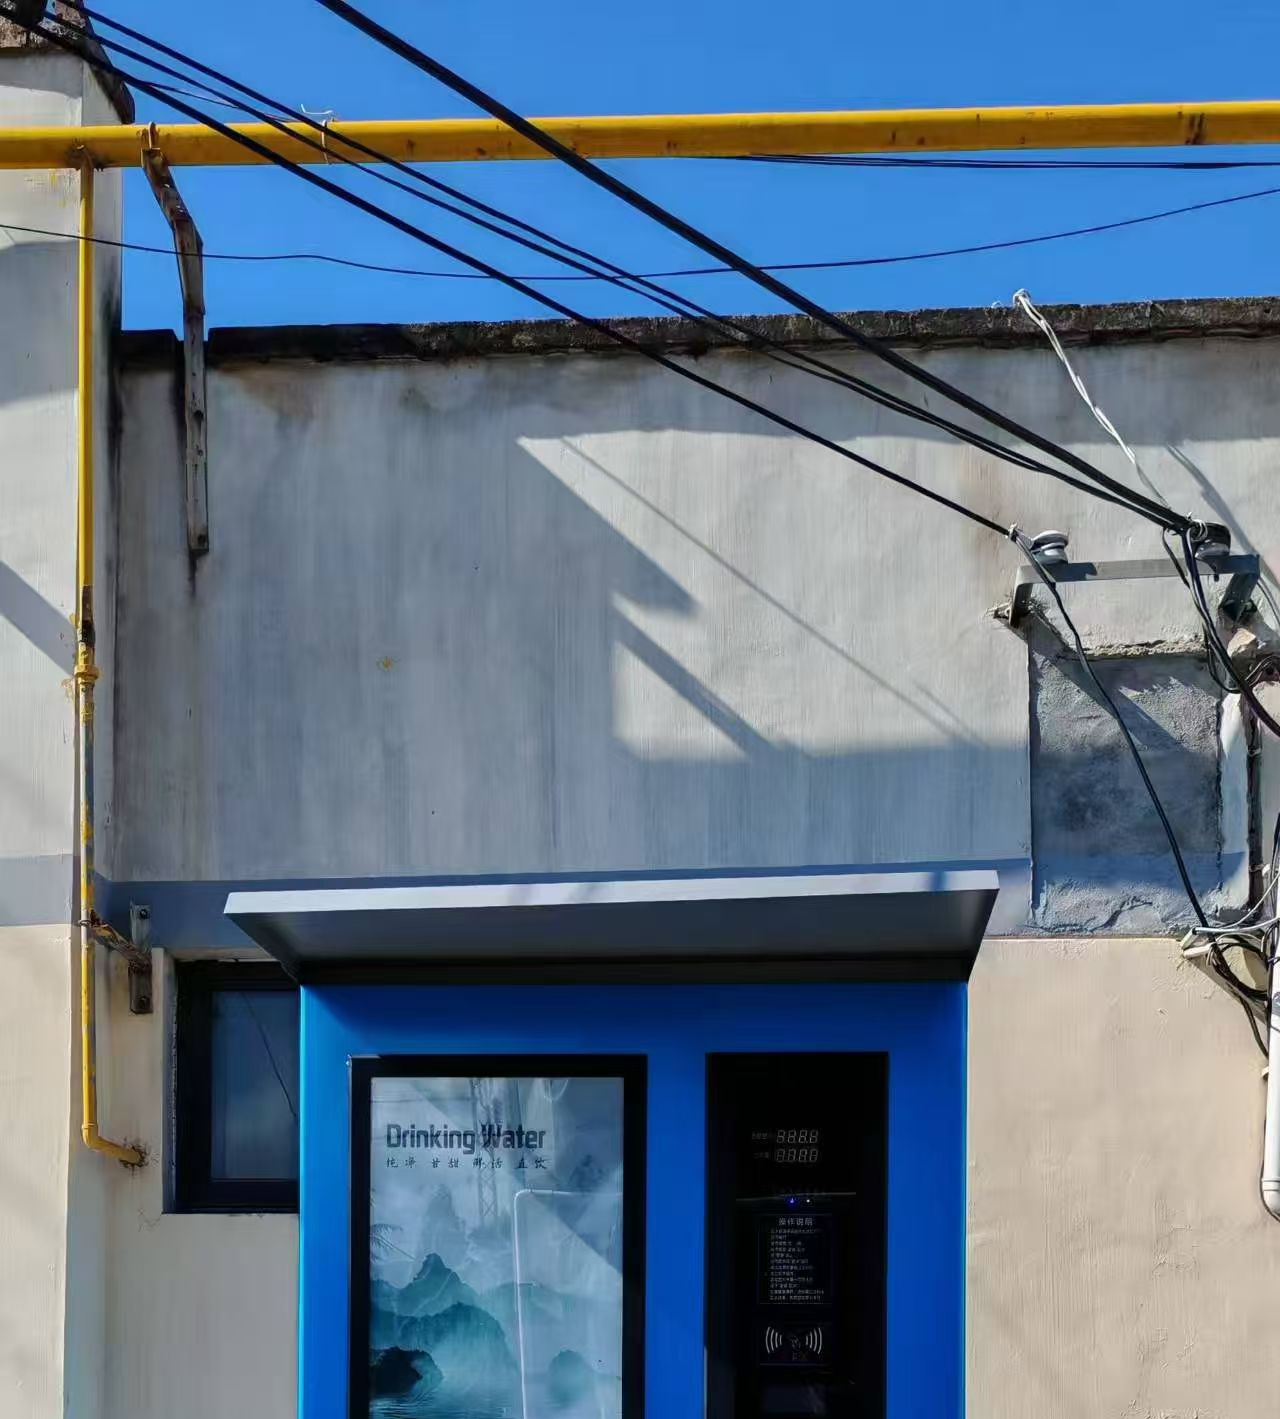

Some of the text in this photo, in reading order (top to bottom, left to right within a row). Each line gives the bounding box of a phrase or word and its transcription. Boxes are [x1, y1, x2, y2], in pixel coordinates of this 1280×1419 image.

[386, 1123, 546, 1155] Drinking Water
[431, 1157, 459, 1169] 甘甜
